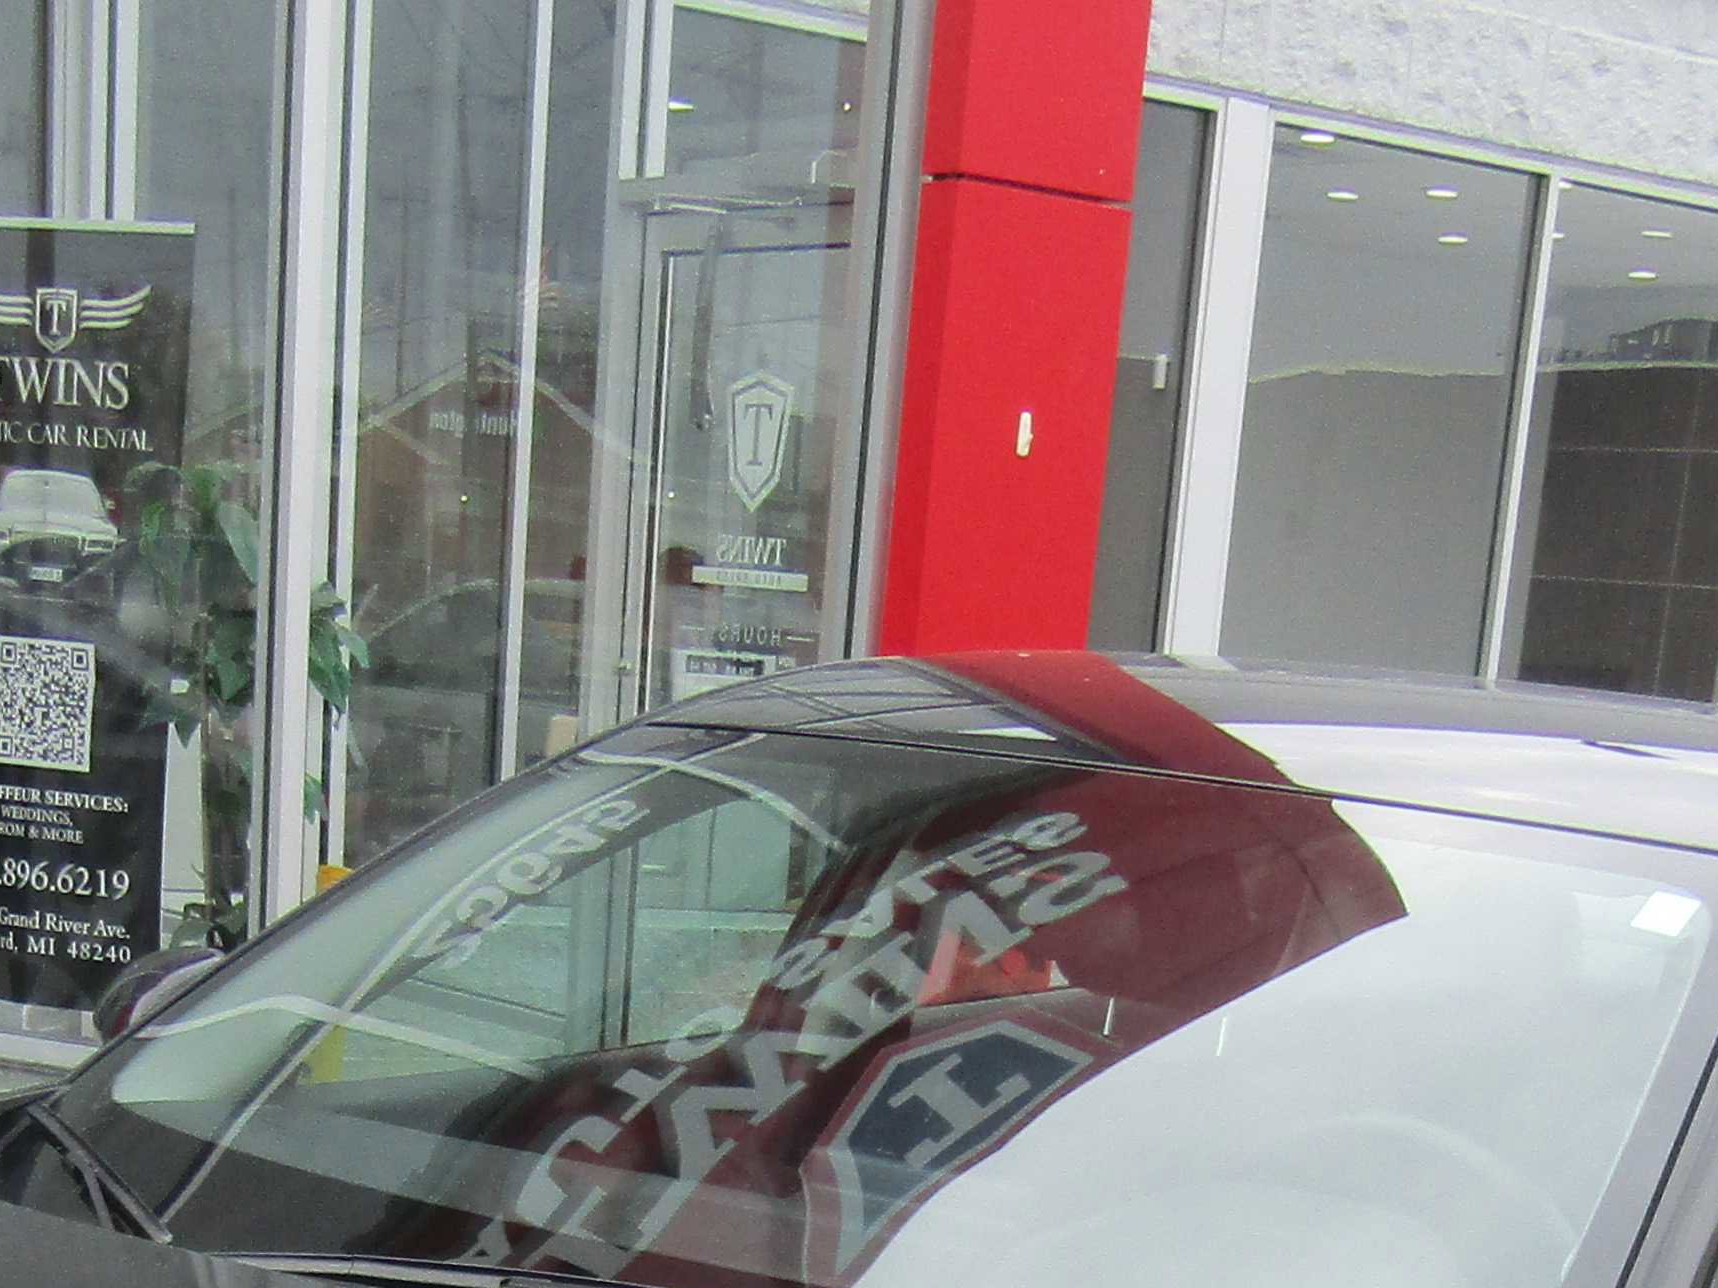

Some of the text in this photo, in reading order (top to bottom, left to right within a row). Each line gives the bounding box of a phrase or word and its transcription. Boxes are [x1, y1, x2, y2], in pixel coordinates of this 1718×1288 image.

[46, 300, 66, 335] T
[28, 422, 70, 446] CAR
[77, 425, 153, 451] RENTAL
[44, 790, 129, 813] SERVICES:
[28, 827, 39, 839] &
[42, 827, 83, 844] MORE
[45, 913, 90, 935] River
[93, 919, 130, 939] Ave.
[27, 935, 56, 956] MI
[67, 941, 131, 963] 48240
